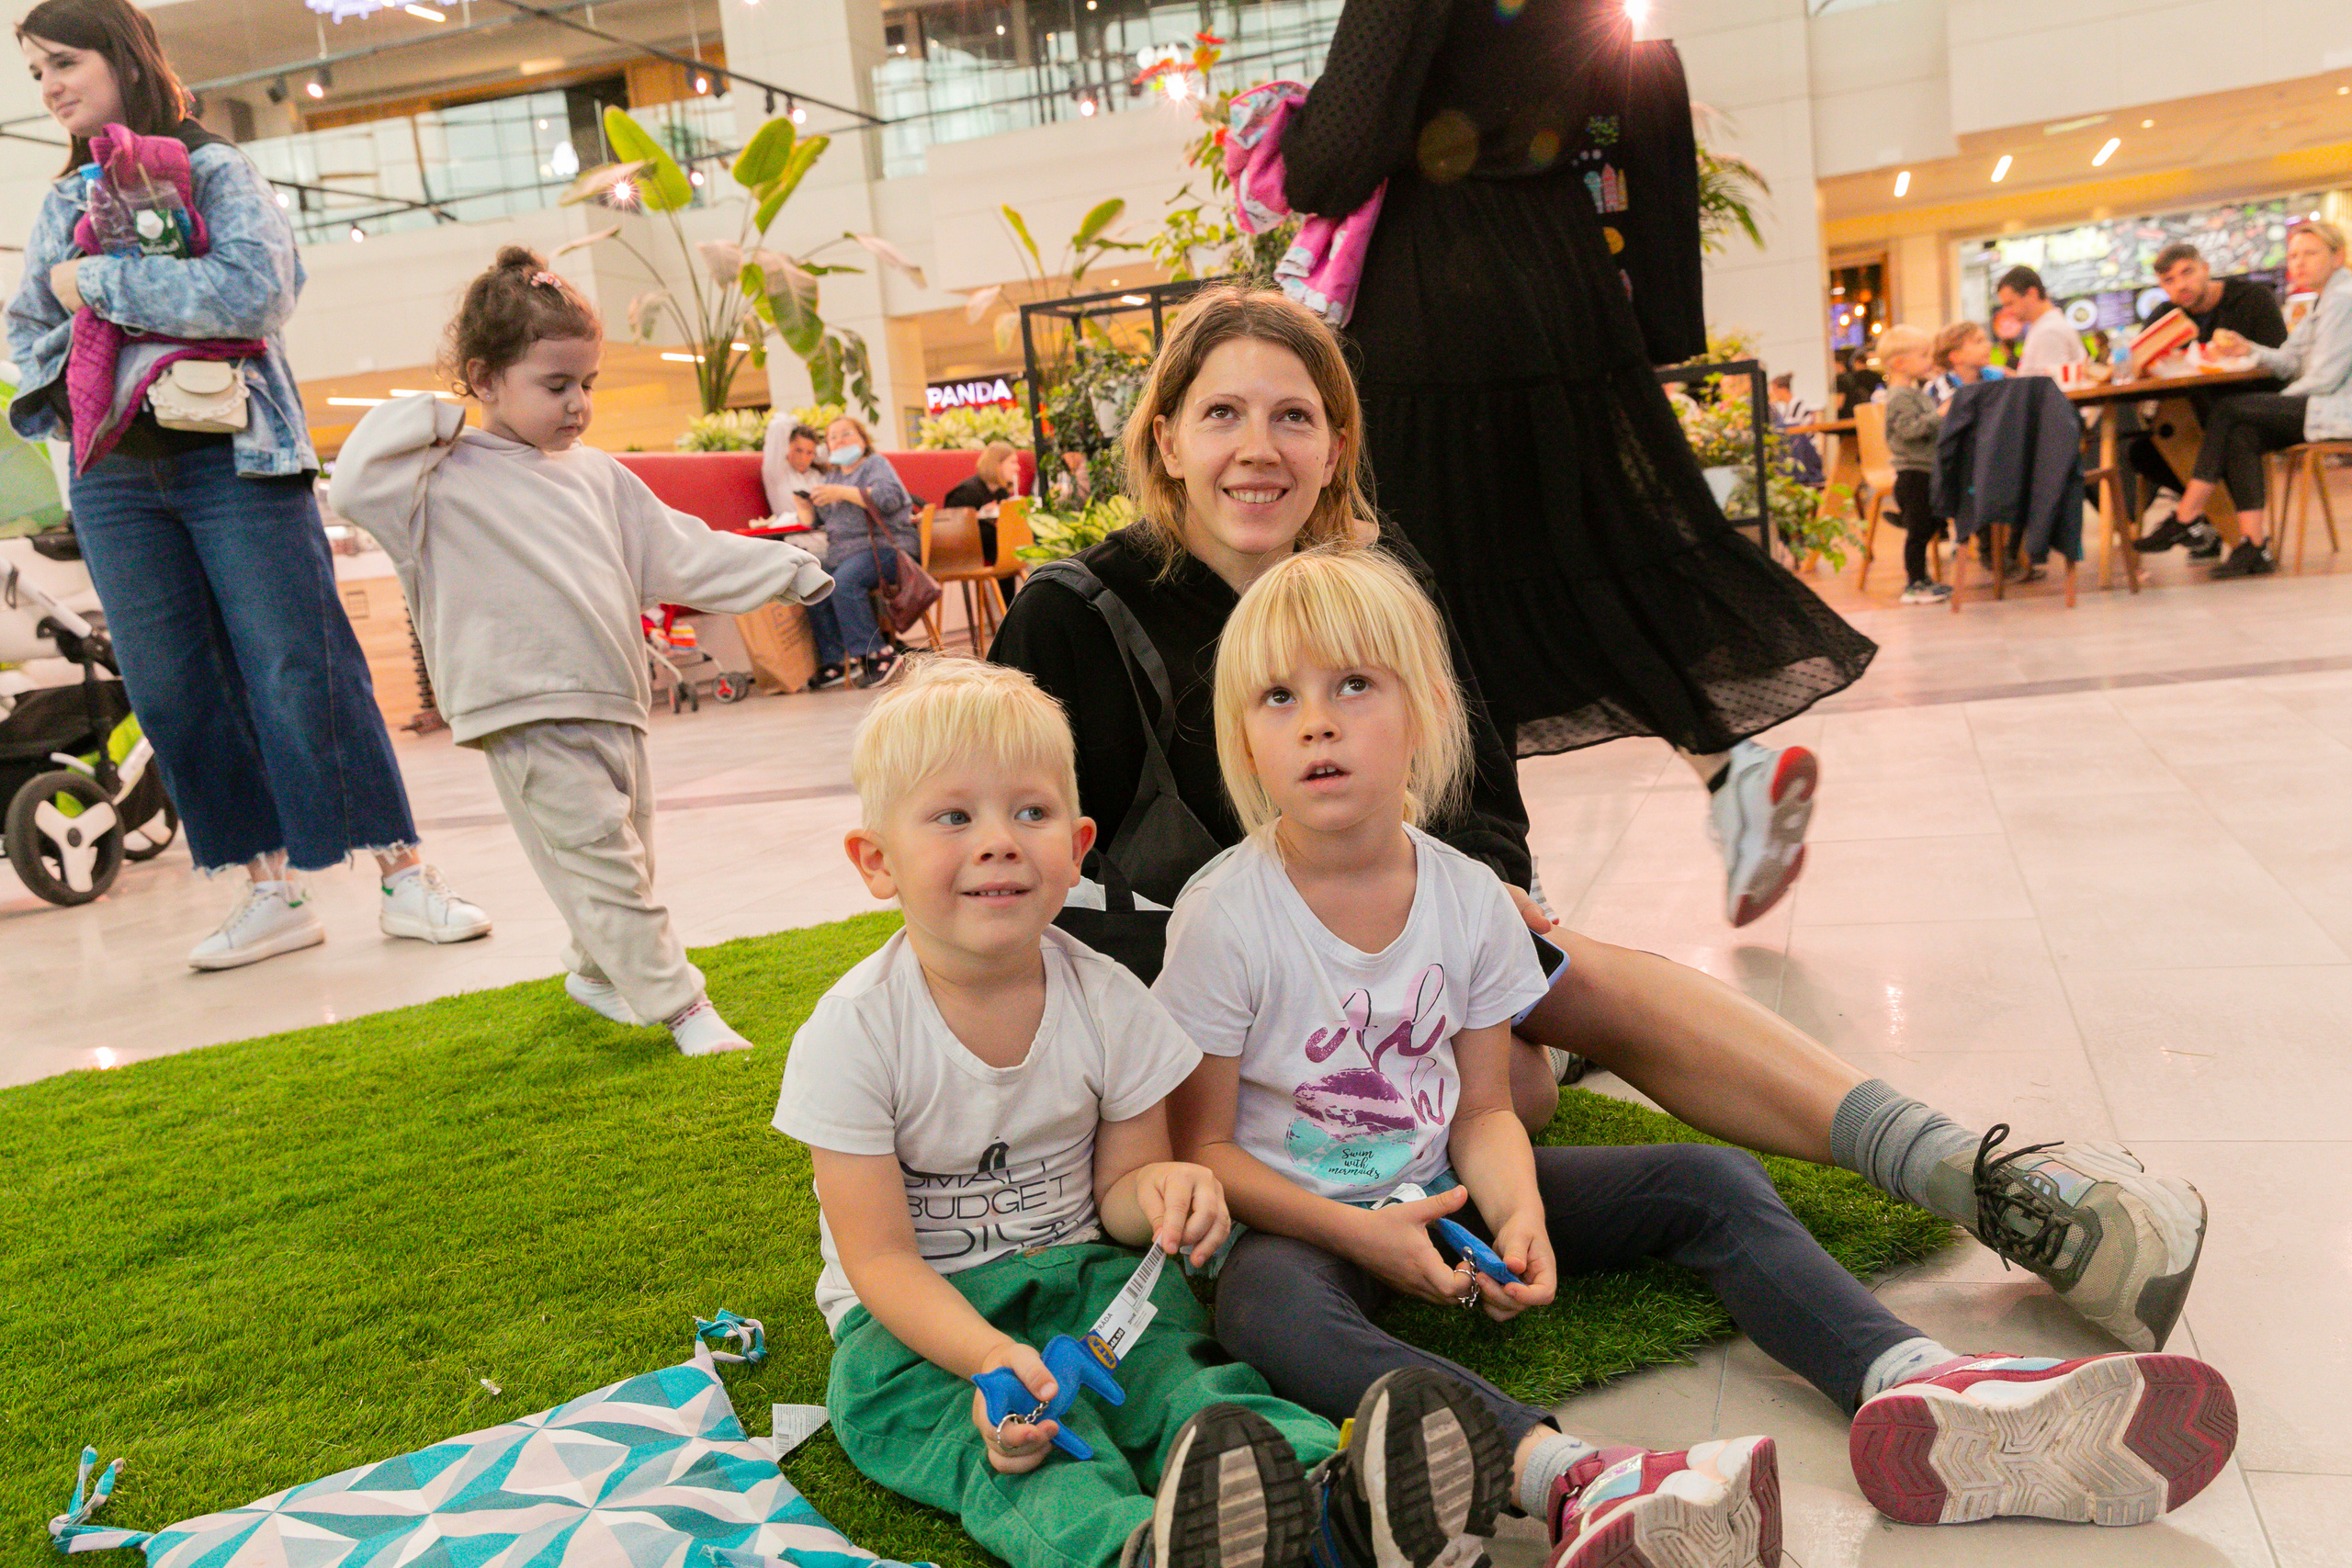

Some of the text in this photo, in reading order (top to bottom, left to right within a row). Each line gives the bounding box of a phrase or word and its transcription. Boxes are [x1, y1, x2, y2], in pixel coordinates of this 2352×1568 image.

[925, 378, 1012, 409] PANDA
[1341, 1148, 1374, 1159] Swim
[1344, 1156, 1369, 1168] with
[1328, 1167, 1380, 1179] mermaids
[907, 1172, 1072, 1219] BUDGET
[1092, 1338, 1114, 1366] IKEA
